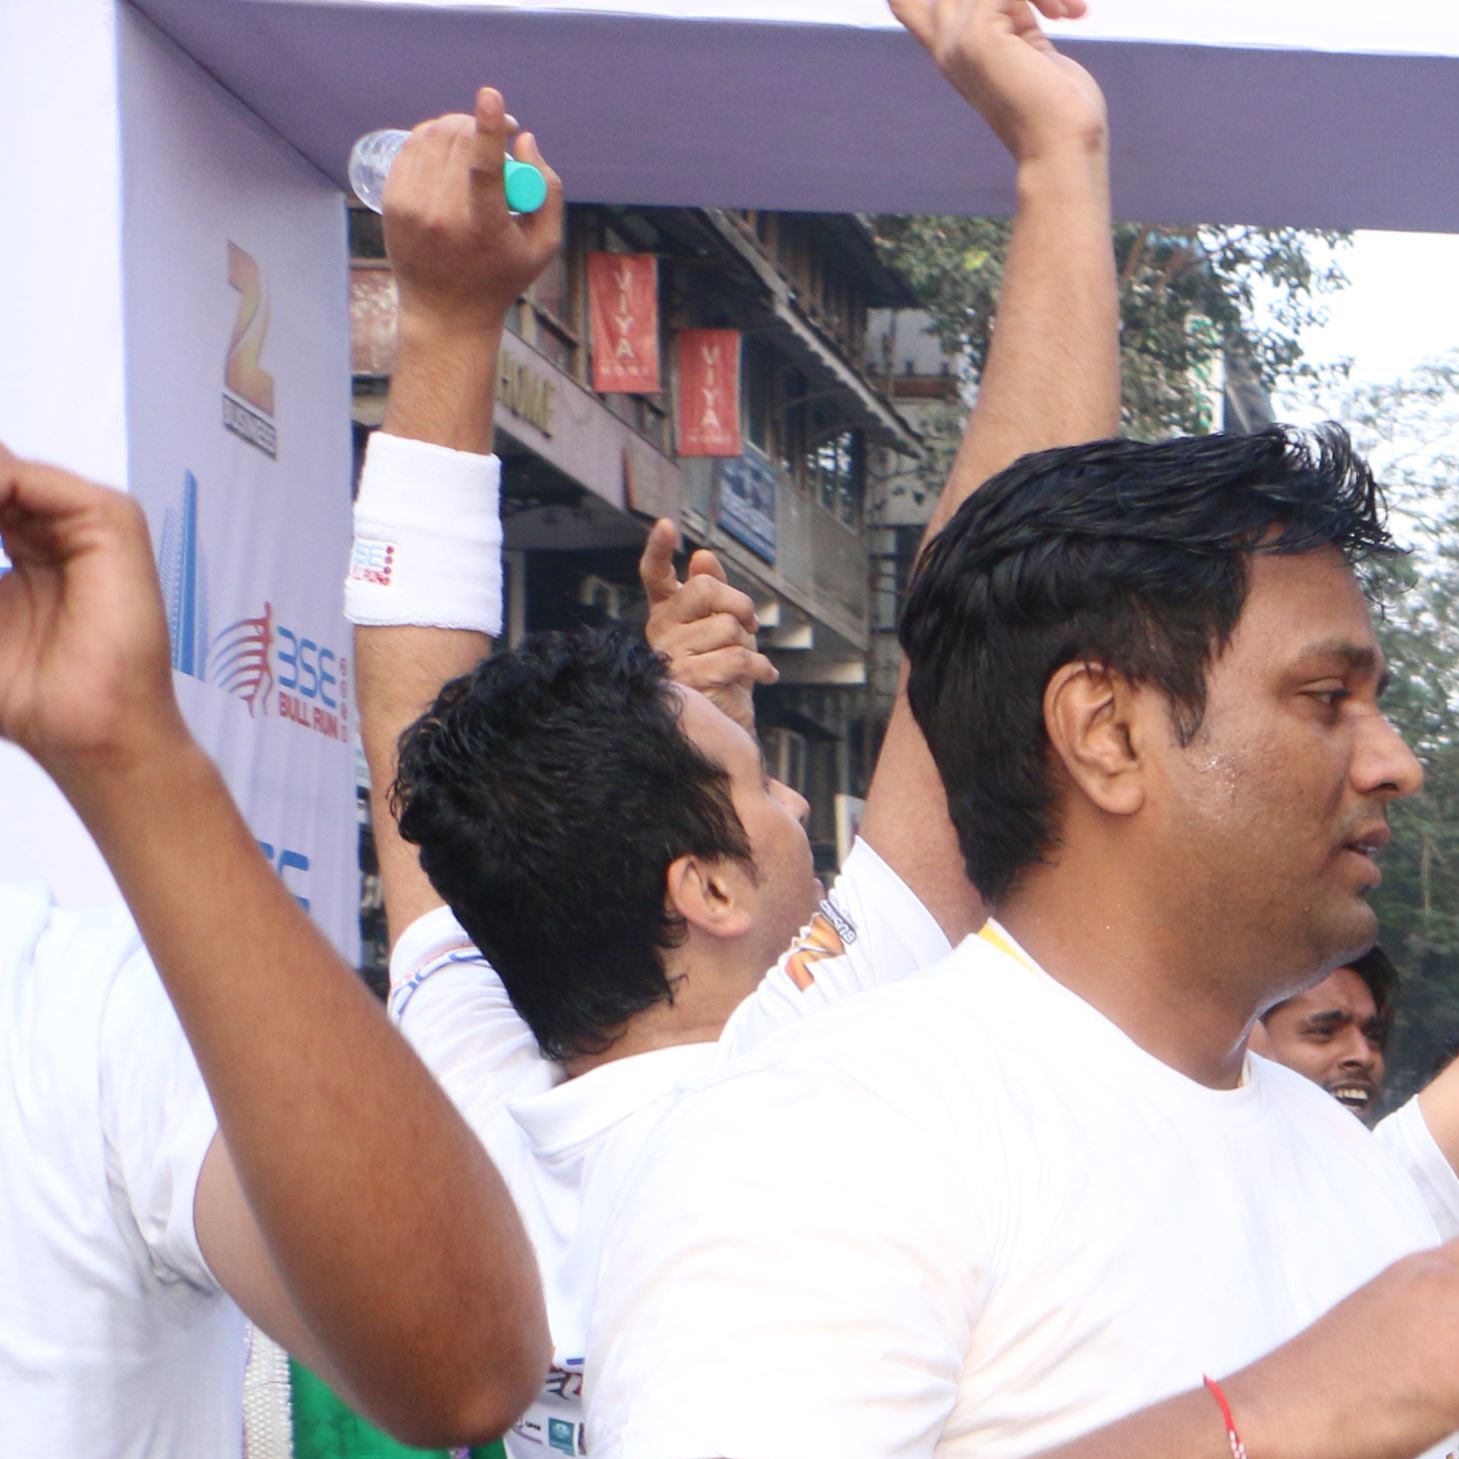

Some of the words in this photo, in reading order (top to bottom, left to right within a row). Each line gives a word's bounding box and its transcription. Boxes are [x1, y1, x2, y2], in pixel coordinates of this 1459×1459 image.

[613, 270, 637, 359] VIYA
[700, 346, 722, 428] VIYA
[279, 691, 310, 727] BULL
[313, 706, 338, 740] RUN
